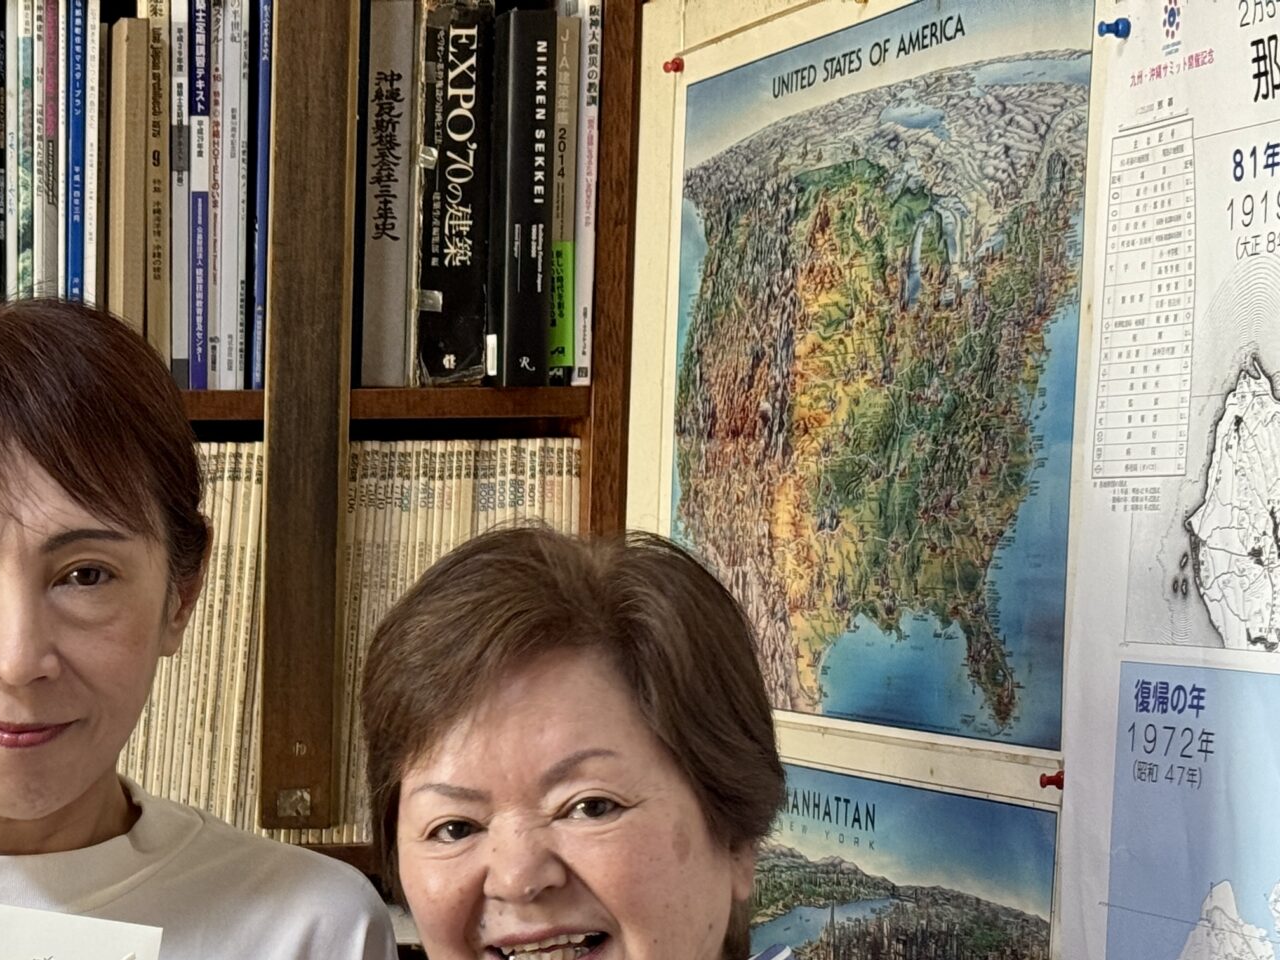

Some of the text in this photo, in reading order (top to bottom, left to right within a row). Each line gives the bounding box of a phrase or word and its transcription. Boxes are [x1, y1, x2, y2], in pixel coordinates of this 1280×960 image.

[773, 14, 965, 99] UNITED STATES OF AMERICA
[533, 40, 548, 204] NIKKEN SEKKEI
[557, 127, 567, 178] 2014
[1134, 678, 1207, 719] 復帰の年
[1127, 721, 1216, 763] 1972年
[824, 829, 876, 850] YORK
